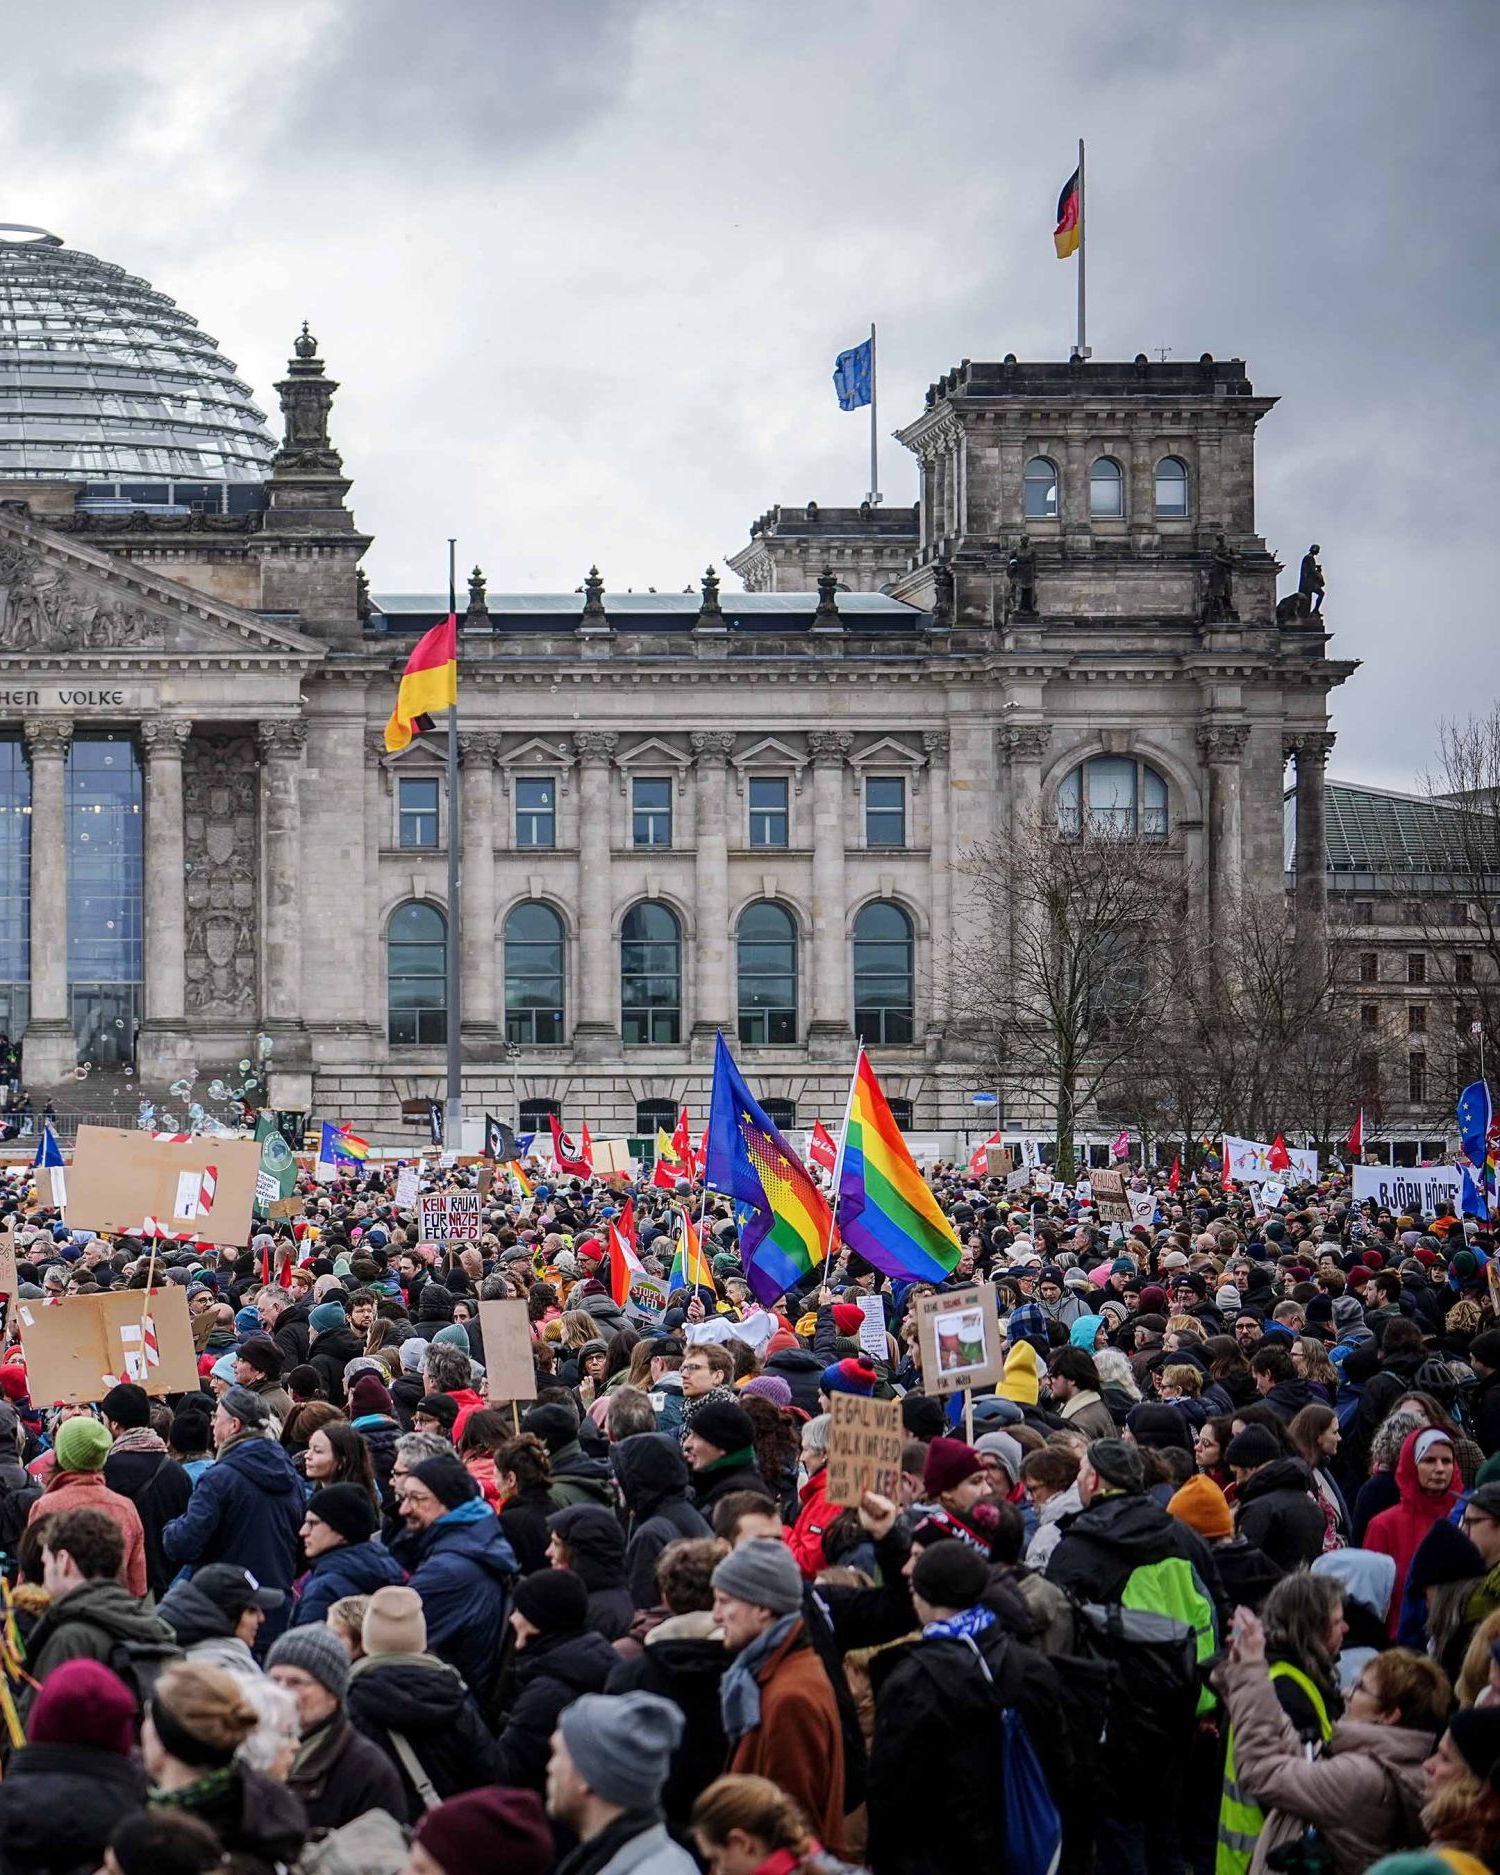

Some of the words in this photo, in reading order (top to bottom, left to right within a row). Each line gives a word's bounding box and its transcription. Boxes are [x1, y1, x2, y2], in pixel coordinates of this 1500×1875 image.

[58, 690, 124, 706] VOLKE
[1379, 1177, 1422, 1210] BJÖRN
[422, 1197, 447, 1213] KEIN
[450, 1196, 478, 1212] RAUM
[424, 1212, 448, 1228] FÜR
[448, 1212, 479, 1227] NAZIS
[425, 1227, 448, 1239] FCK
[448, 1227, 478, 1239] AFD
[632, 1284, 663, 1301] STOPPT
[639, 1297, 658, 1310] AFD
[835, 1397, 870, 1427] EGAL
[874, 1404, 898, 1432] WIE
